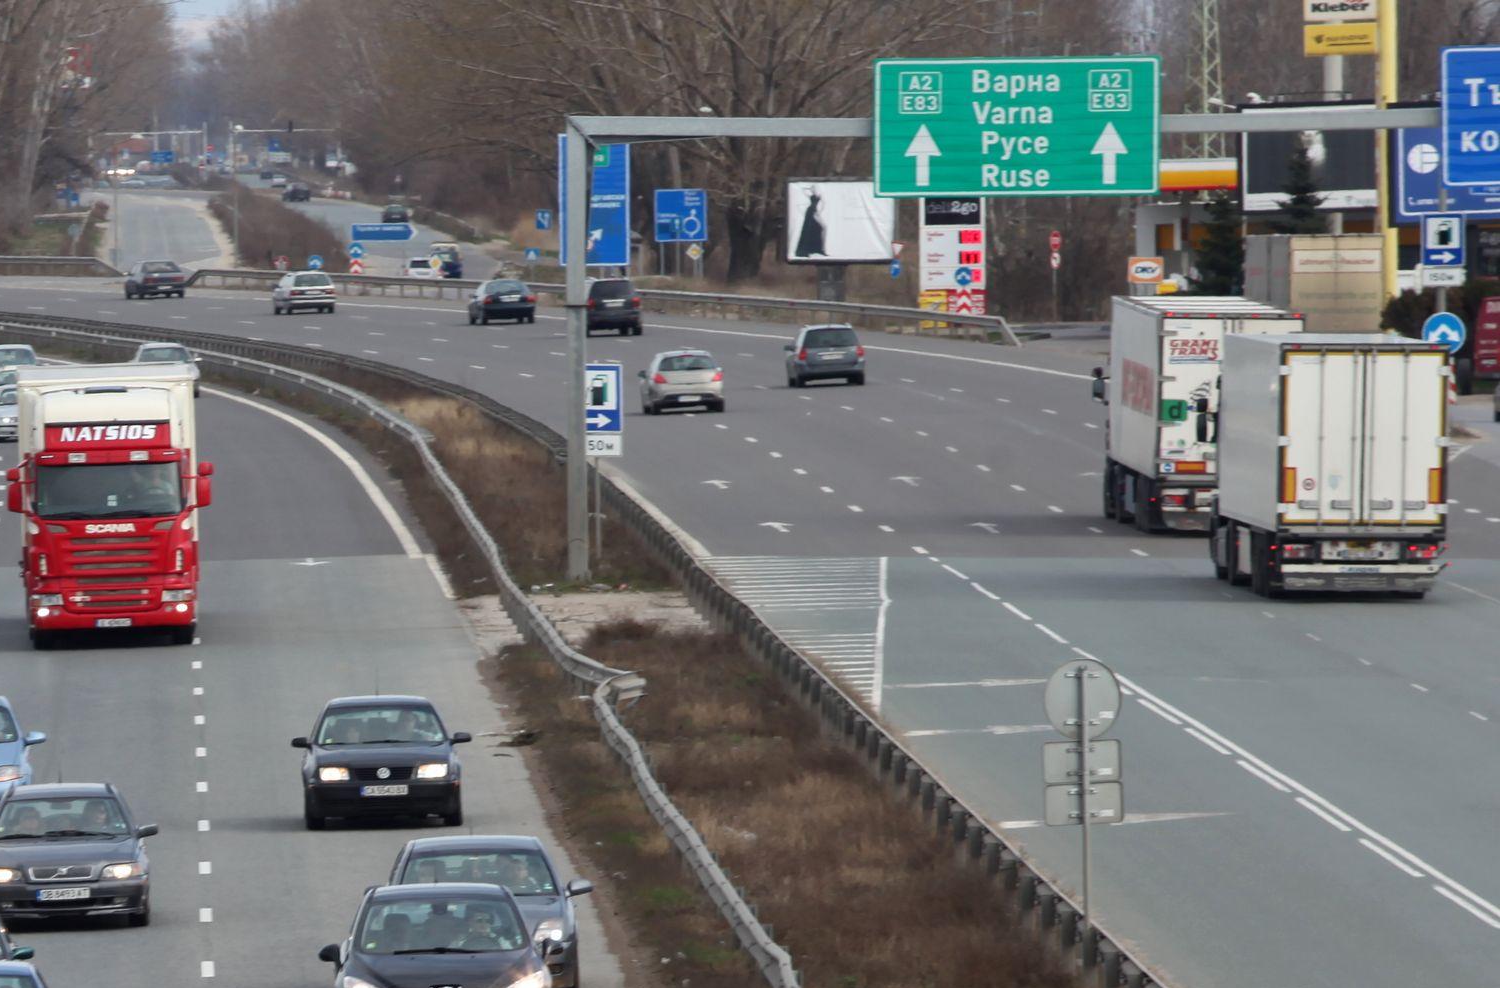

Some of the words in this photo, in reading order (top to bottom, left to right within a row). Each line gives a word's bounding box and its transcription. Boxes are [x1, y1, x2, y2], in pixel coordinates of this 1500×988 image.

[1311, 2, 1369, 12] Kleber
[909, 75, 933, 91] A2
[972, 69, 1060, 98] Варна
[1098, 73, 1122, 88] A2
[903, 96, 938, 110] E83
[1092, 94, 1127, 108] E83
[972, 101, 1053, 125] Varna
[981, 131, 1049, 160] Русе
[981, 164, 1050, 187] Ruse
[60, 425, 157, 441] NATSIOS
[85, 523, 136, 533] SCANIA
